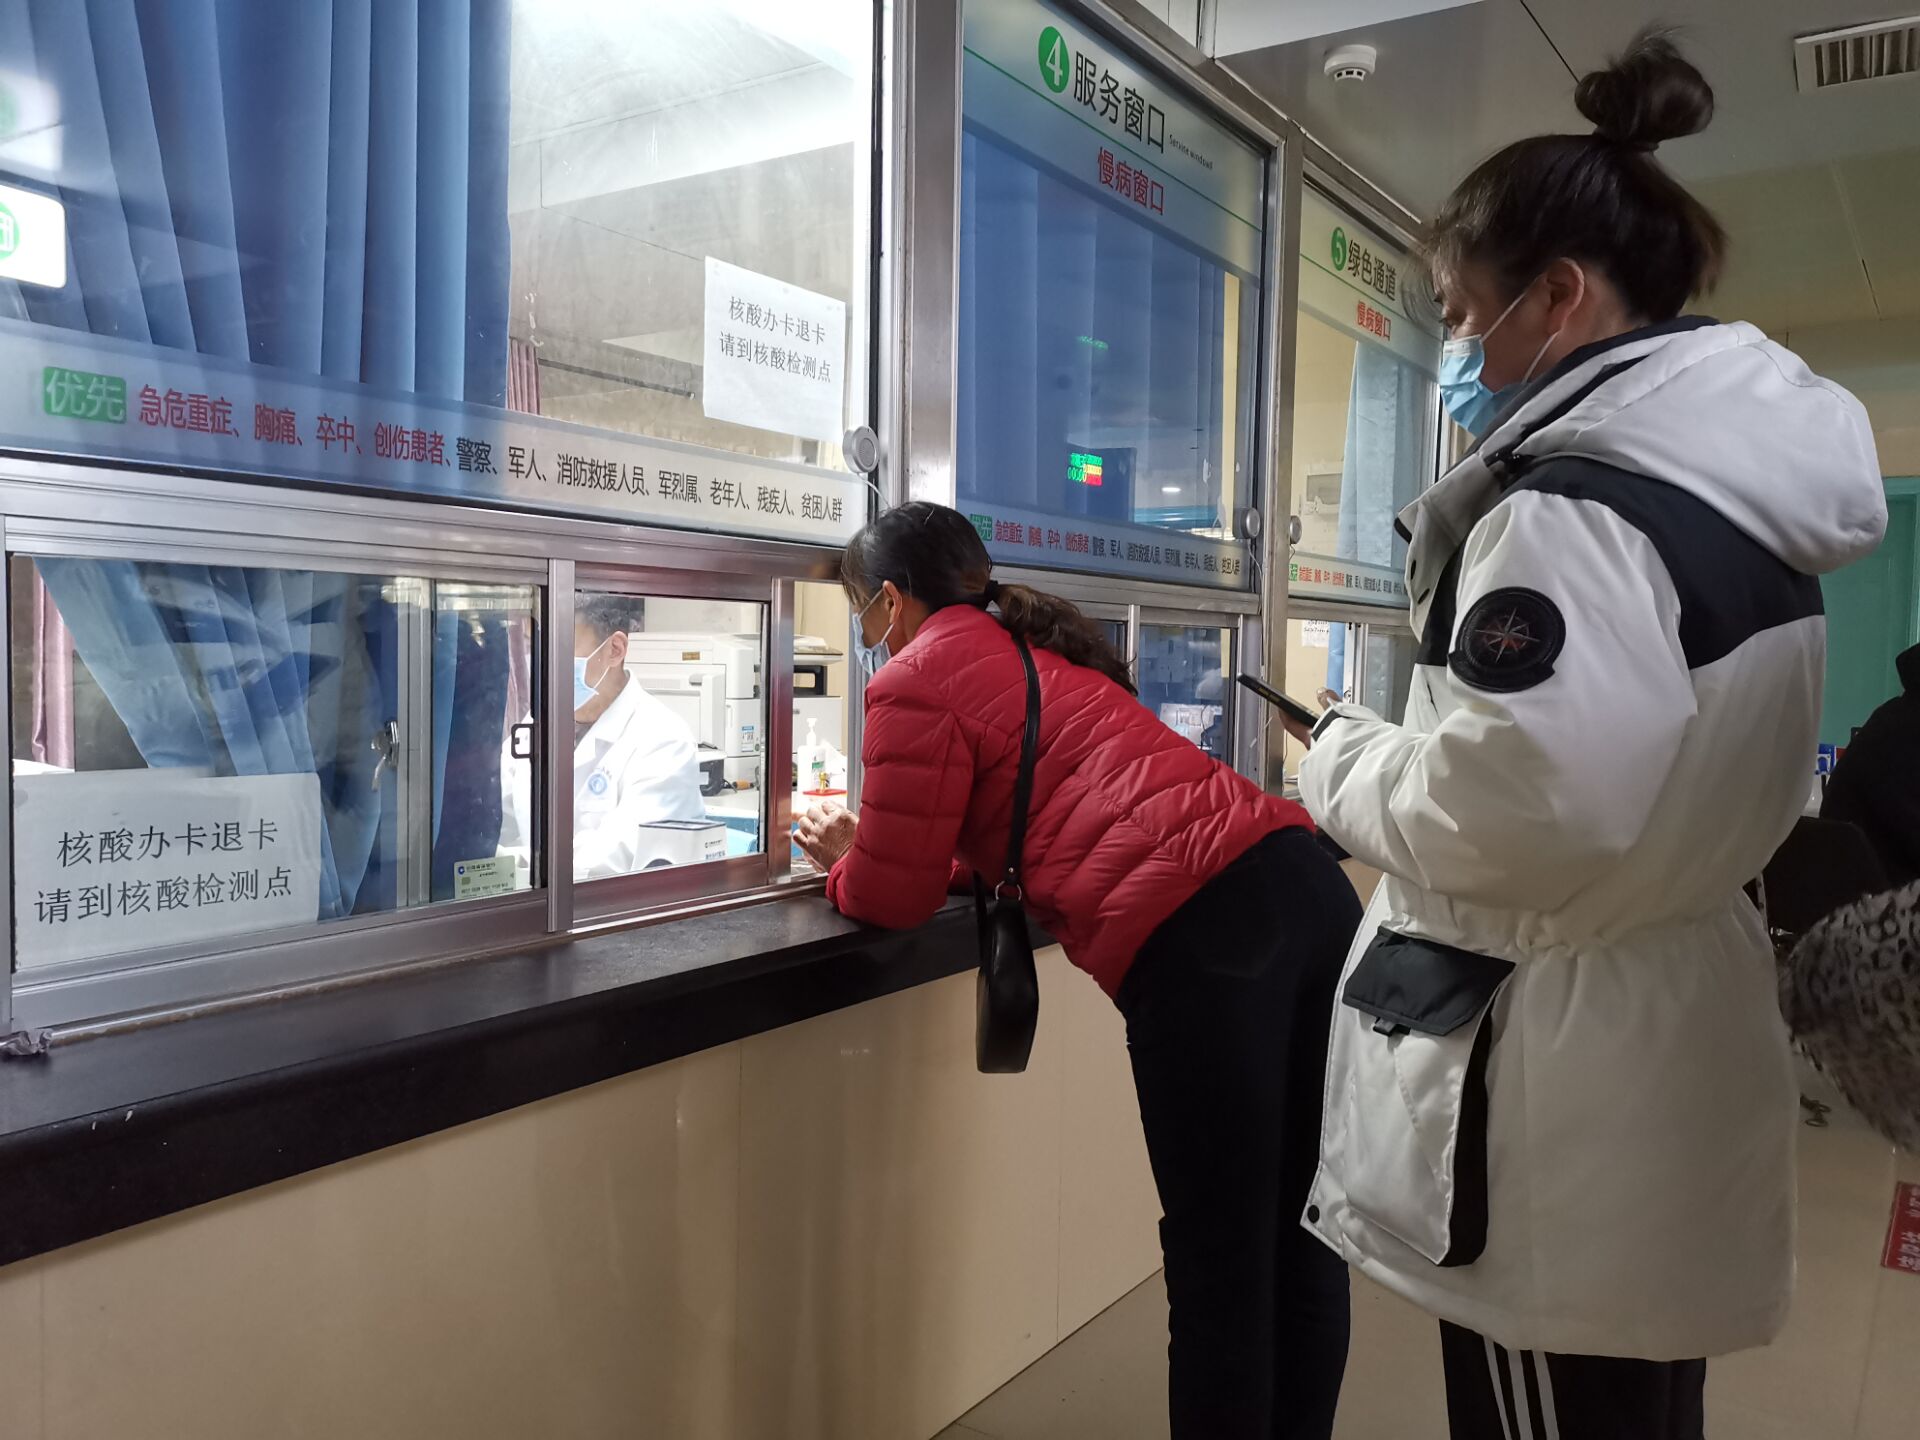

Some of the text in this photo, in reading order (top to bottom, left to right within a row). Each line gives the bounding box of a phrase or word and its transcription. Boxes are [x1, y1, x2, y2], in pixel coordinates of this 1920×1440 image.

[1045, 36, 1166, 154] 4 服务窗口
[1097, 146, 1165, 216] 慢病窗口
[1348, 239, 1397, 302] 绿色通道
[728, 296, 826, 345] 核酸办卡退卡
[1356, 300, 1392, 341] 慢病窗口
[719, 331, 832, 383] 请到核酸检测点
[45, 368, 126, 422] 优先
[56, 817, 279, 868] 核酸办卡退卡
[33, 865, 292, 925] 请到核酸检测点
